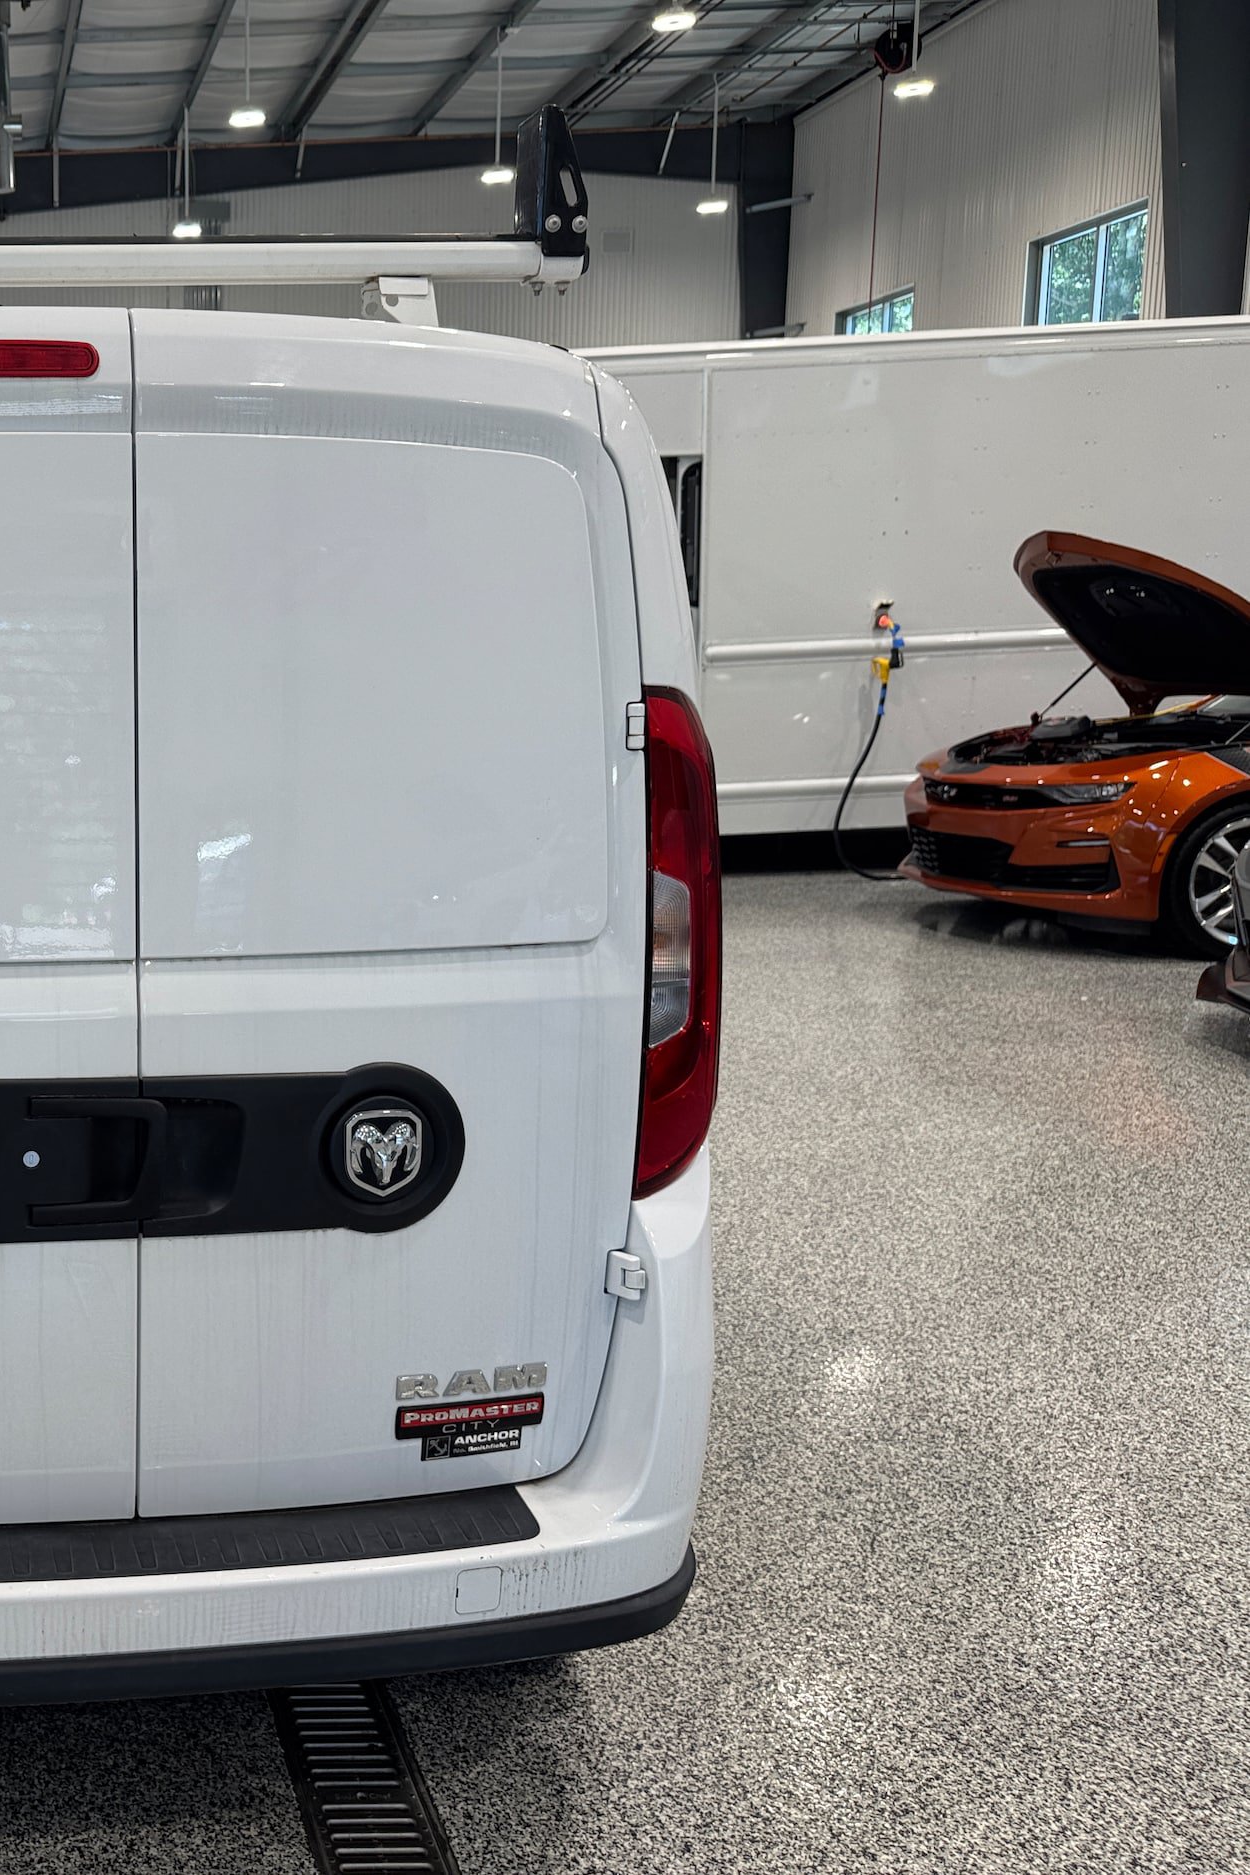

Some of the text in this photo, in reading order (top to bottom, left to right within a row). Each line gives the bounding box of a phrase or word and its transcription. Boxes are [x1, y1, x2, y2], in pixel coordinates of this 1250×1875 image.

[396, 1362, 548, 1400] RAM
[403, 1401, 539, 1424] PROMASTER
[442, 1419, 500, 1434] CITY
[454, 1429, 520, 1445] ANCHOR
